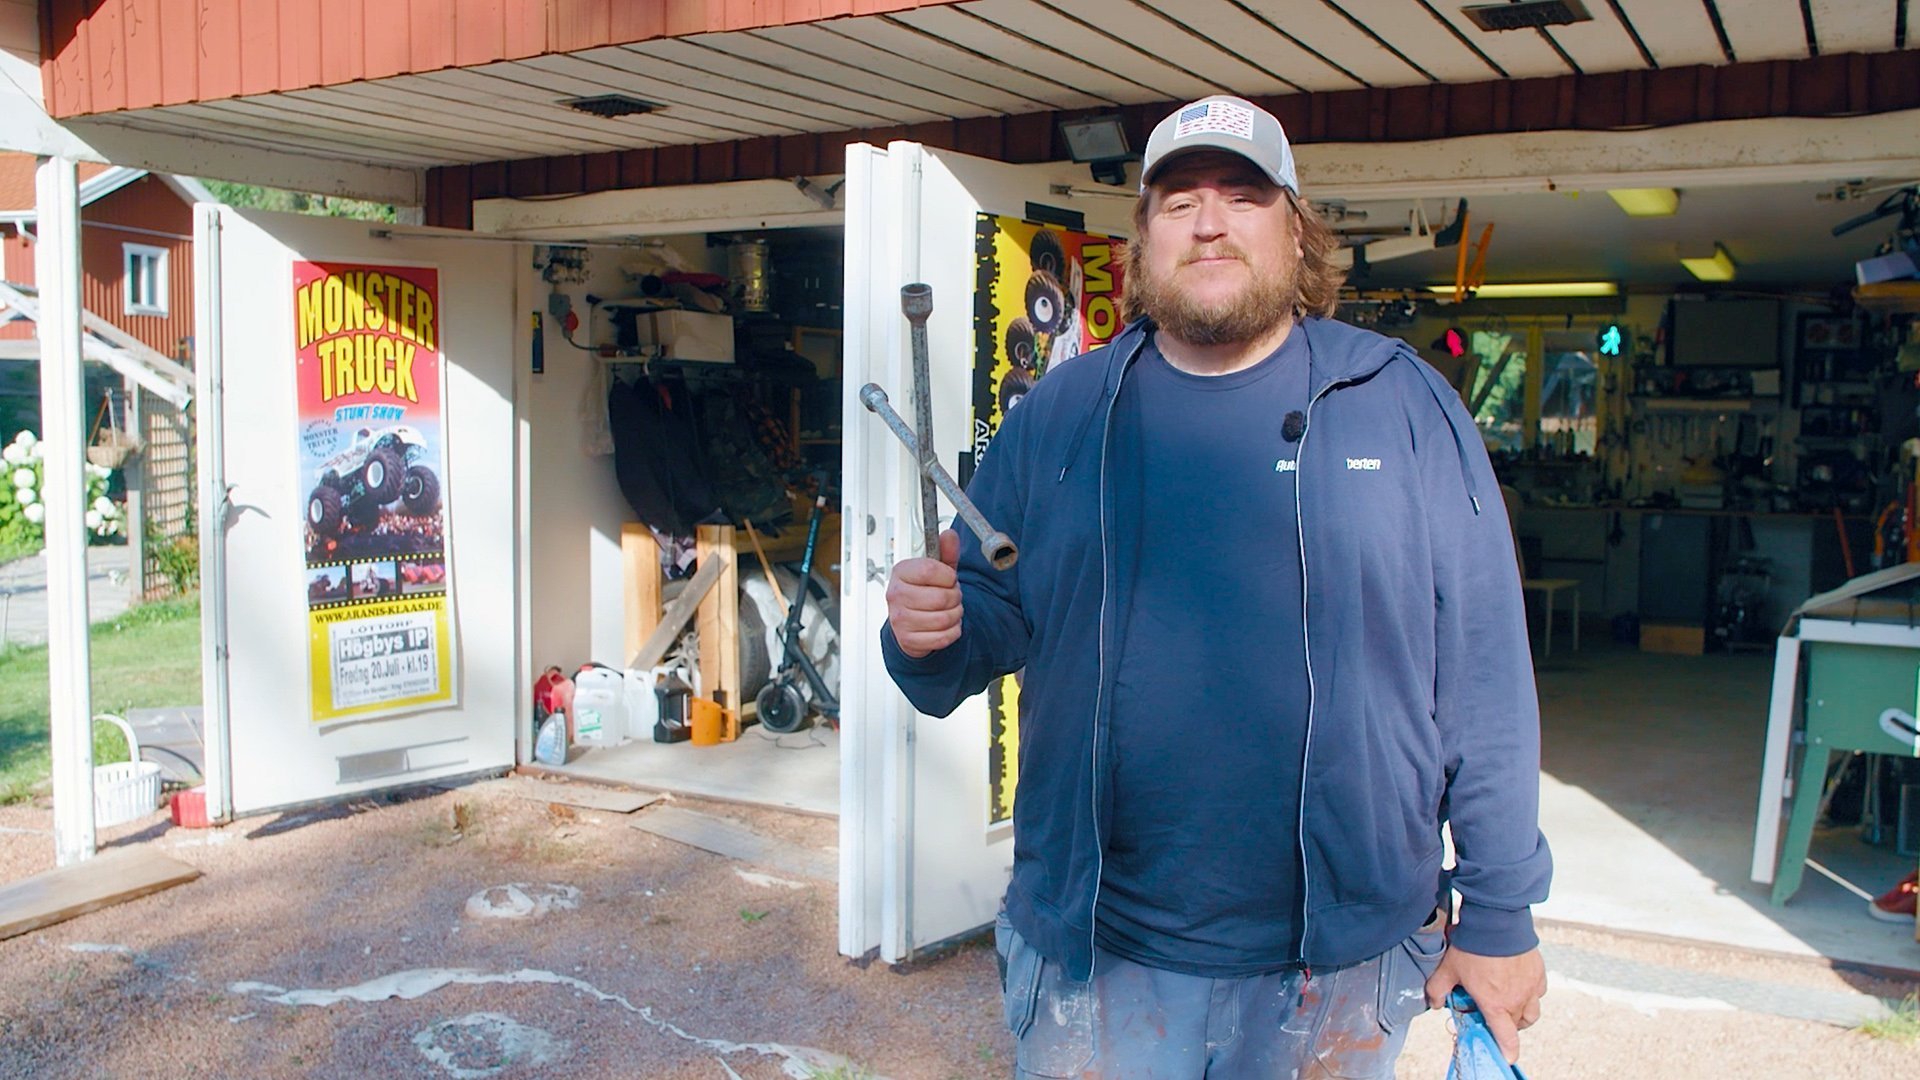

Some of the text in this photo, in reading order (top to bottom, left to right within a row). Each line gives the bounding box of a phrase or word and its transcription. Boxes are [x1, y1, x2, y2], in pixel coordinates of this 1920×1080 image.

[1082, 243, 1116, 352] MO
[297, 271, 435, 353] MONSTER
[317, 333, 419, 403] TRUCK
[336, 402, 406, 422] STUNT SHOW
[303, 427, 338, 442] MONSTER
[315, 601, 443, 624] WWW.ARANIS-KLAAS.DE
[408, 627, 428, 649] IP
